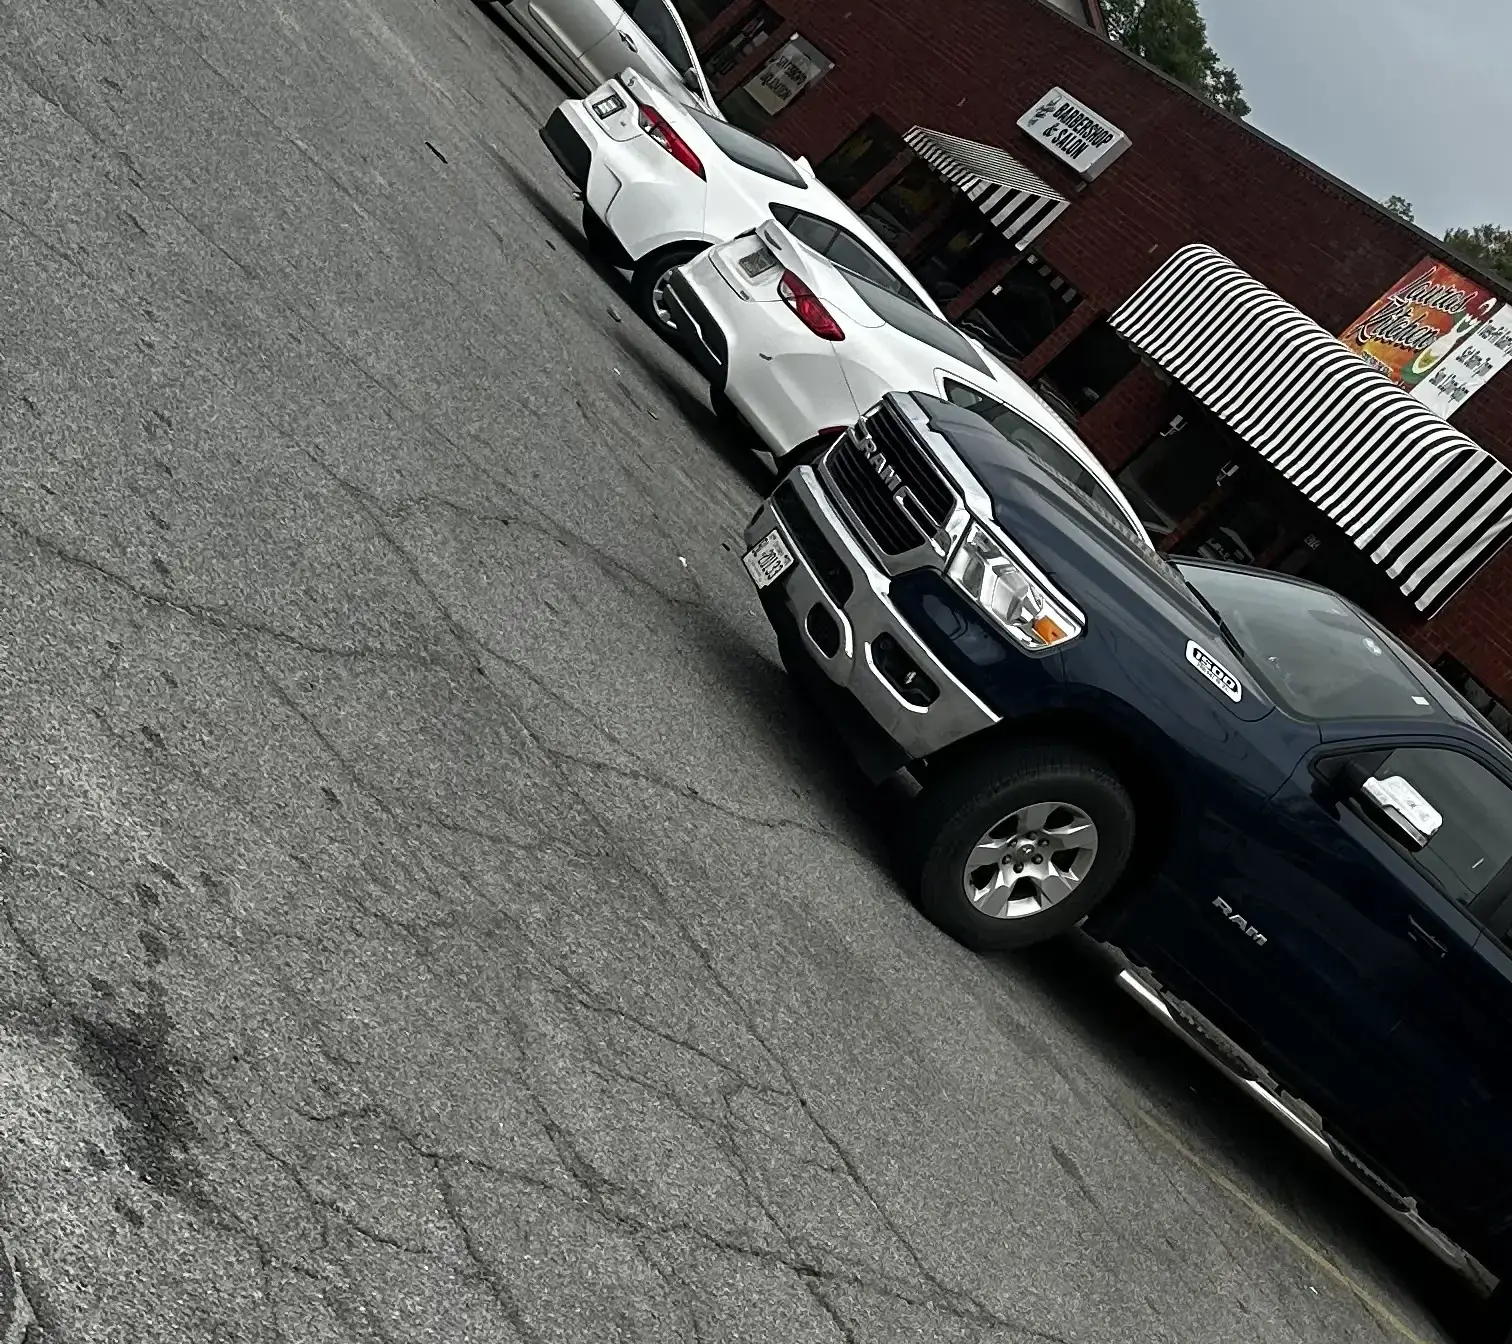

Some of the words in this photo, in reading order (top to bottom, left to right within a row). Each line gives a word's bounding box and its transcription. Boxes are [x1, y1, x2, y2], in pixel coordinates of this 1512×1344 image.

[1043, 123, 1060, 137] &
[1052, 129, 1089, 159] SALON
[1053, 102, 1104, 148] BARBERSHOP
[1347, 299, 1441, 351] Kitchen
[861, 437, 902, 492] RAM
[1195, 650, 1237, 690] 1500
[1212, 896, 1268, 946] RAM
